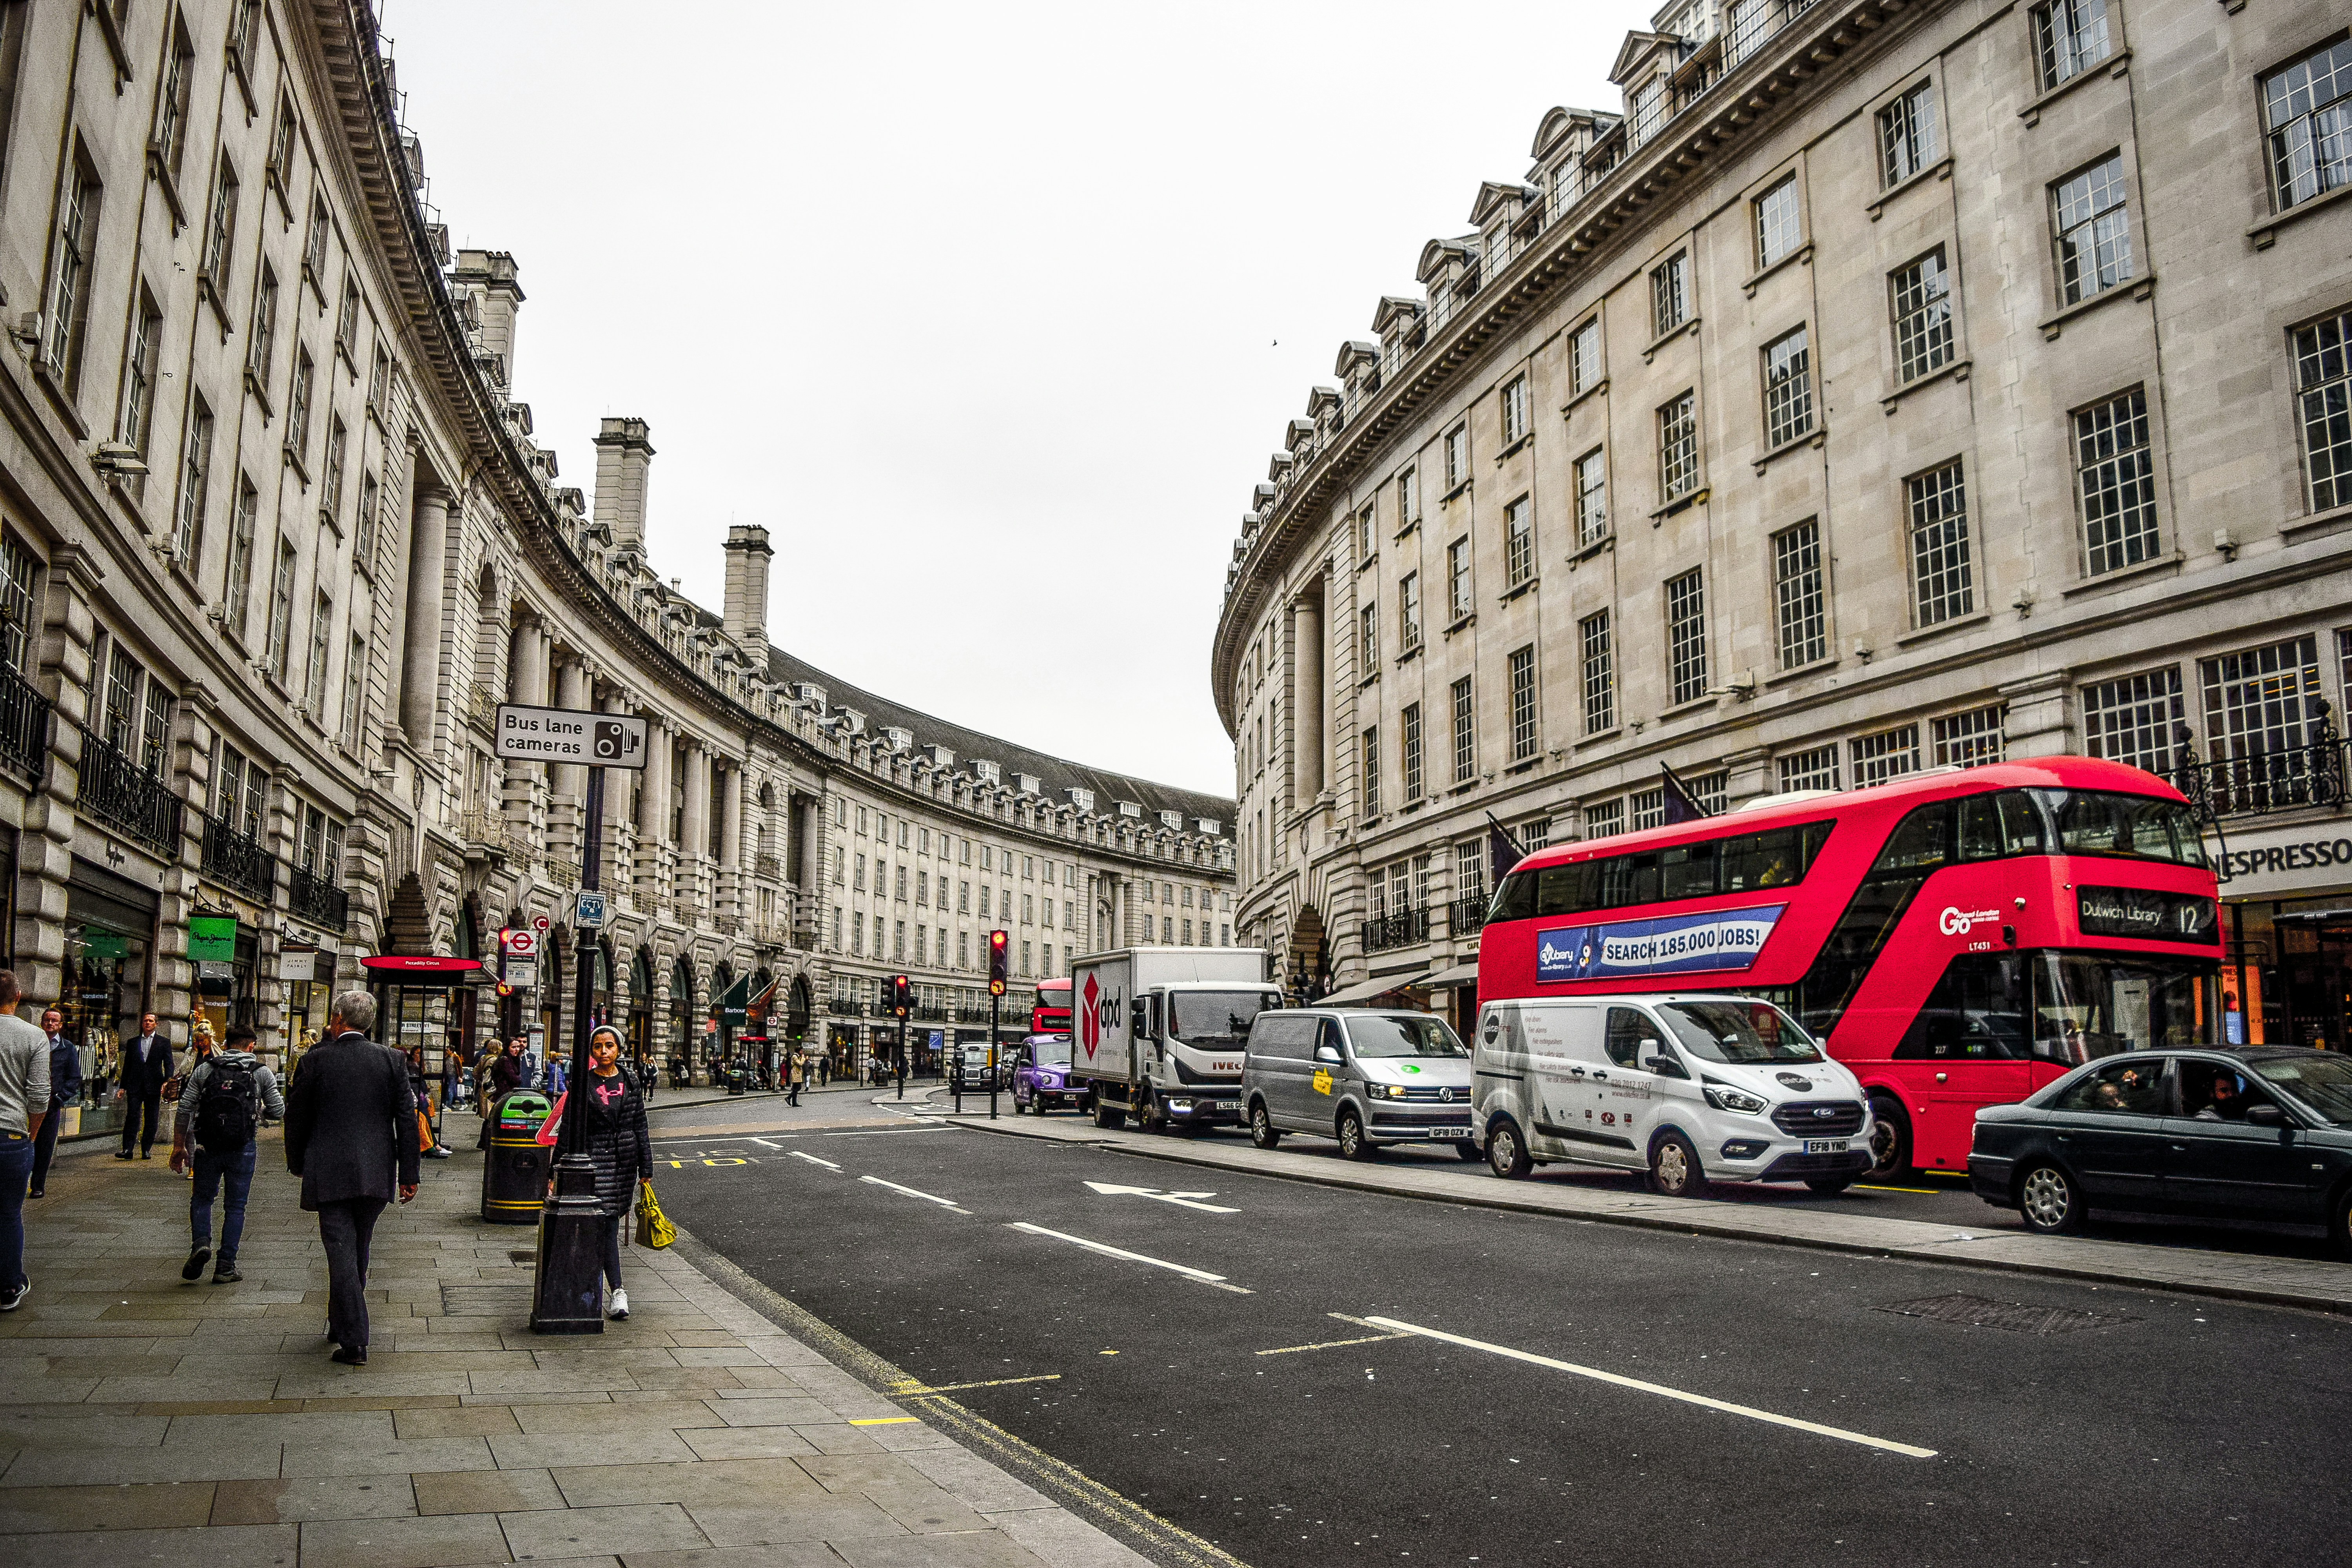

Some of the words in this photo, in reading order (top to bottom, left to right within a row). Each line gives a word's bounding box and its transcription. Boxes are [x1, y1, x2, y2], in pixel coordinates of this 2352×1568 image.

[506, 714, 539, 731] Bus
[546, 718, 583, 735] lane
[505, 737, 581, 754] cameras
[581, 899, 603, 909] CCTV
[536, 918, 547, 929] C
[1939, 906, 1971, 936] Go
[2083, 900, 2124, 918] Dulwich
[2127, 905, 2161, 926] Library
[2180, 906, 2198, 934] 12
[192, 932, 209, 943] Pepe
[209, 934, 231, 944] Jeans
[1606, 942, 1657, 960] SEARCH
[1660, 930, 1715, 957] 185,000
[1718, 928, 1760, 947] JOBS!
[1100, 986, 1121, 1039] dpd
[1212, 1062, 1244, 1070] IVEC
[1810, 1142, 1829, 1152] EF18
